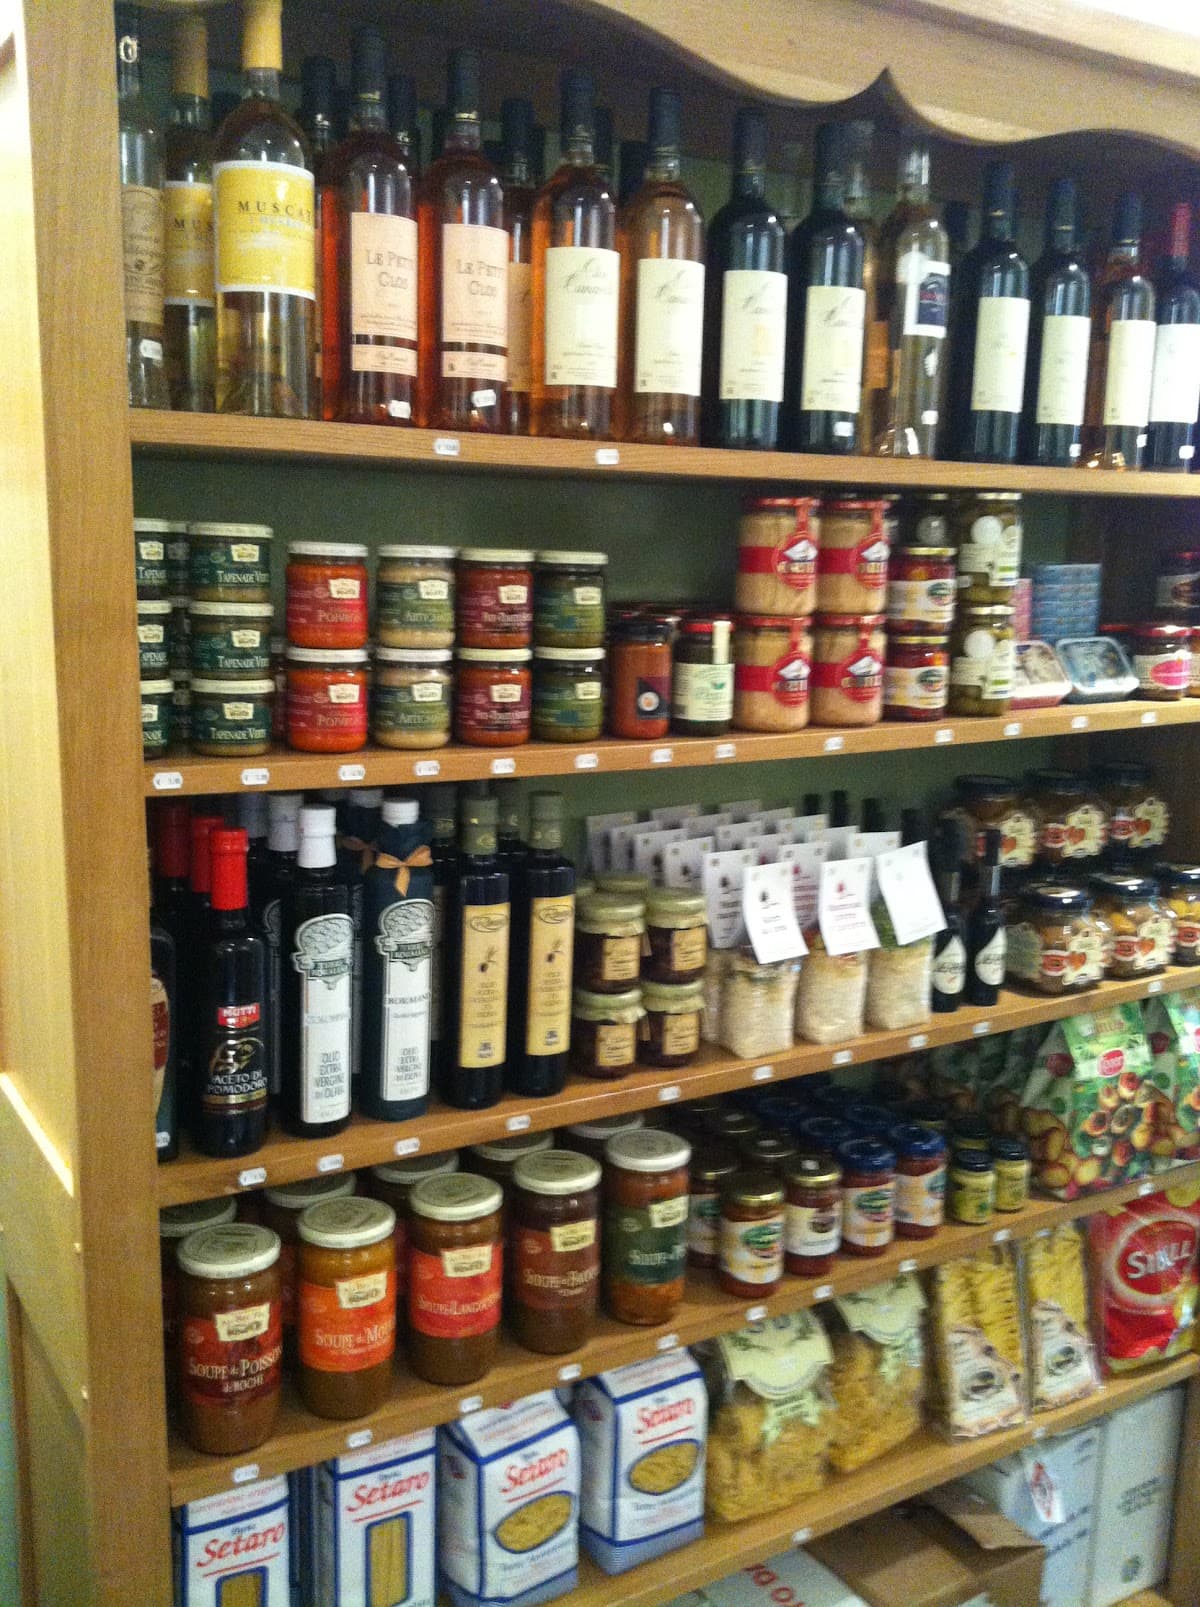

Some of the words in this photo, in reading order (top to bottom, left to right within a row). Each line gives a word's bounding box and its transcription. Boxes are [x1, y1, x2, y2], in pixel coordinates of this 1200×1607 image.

[207, 1077, 268, 1094] POMODORO
[211, 1074, 250, 1086] ACETO
[252, 1070, 263, 1083] DI
[188, 1357, 228, 1379] SOUPE
[346, 1471, 430, 1513] Setaro
[197, 1523, 285, 1566] Setaro
